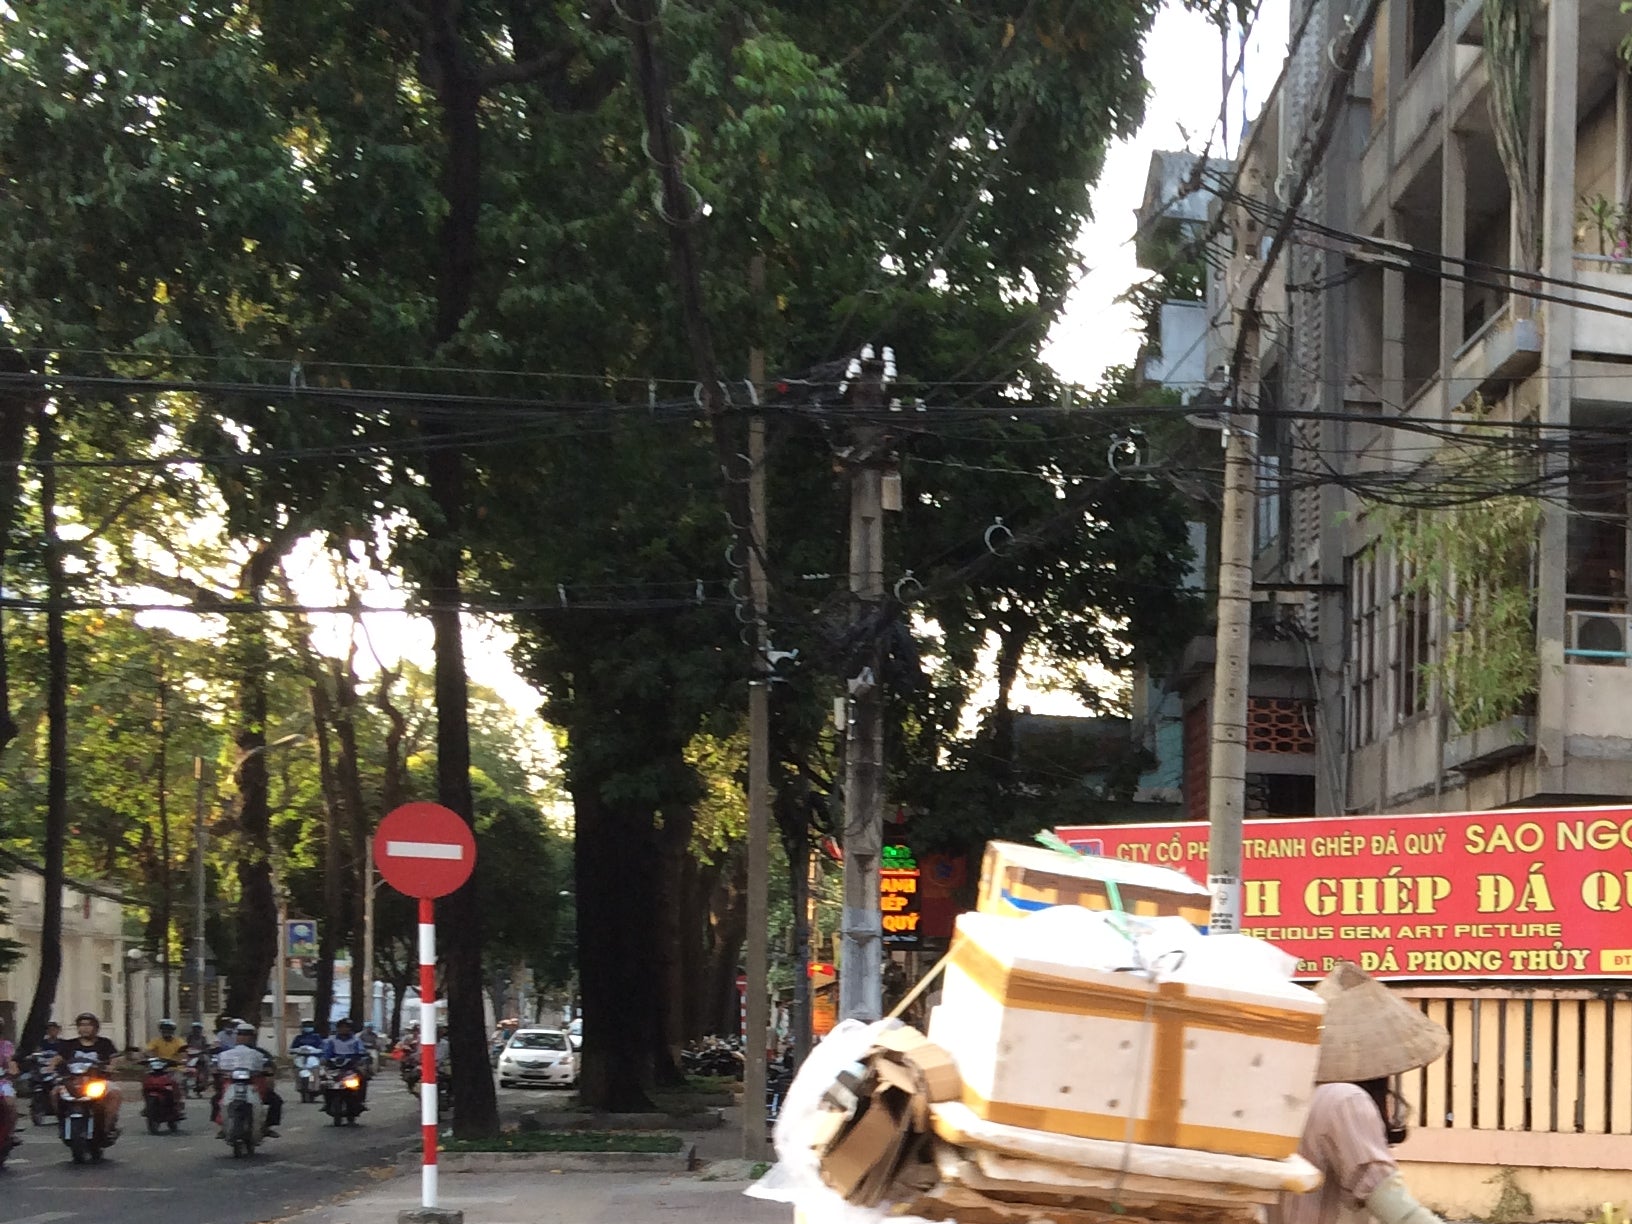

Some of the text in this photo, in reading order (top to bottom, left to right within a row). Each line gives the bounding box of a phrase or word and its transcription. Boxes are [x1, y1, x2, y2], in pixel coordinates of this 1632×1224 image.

[1116, 843, 1152, 863] CTY
[1242, 838, 1306, 859] TRANH
[1311, 831, 1366, 858] GHÉP
[1371, 831, 1398, 856] ĐÁ
[1464, 822, 1546, 854] SAO
[1303, 867, 1452, 916] GHÉP
[1476, 863, 1556, 914] ĐÁ
[1340, 926, 1391, 939] GEM
[1397, 924, 1448, 939] ART
[1454, 923, 1562, 938] PICTURE
[1360, 946, 1399, 972] ĐÁ
[1407, 950, 1503, 972] PHONG
[1509, 943, 1590, 972] THỦY
